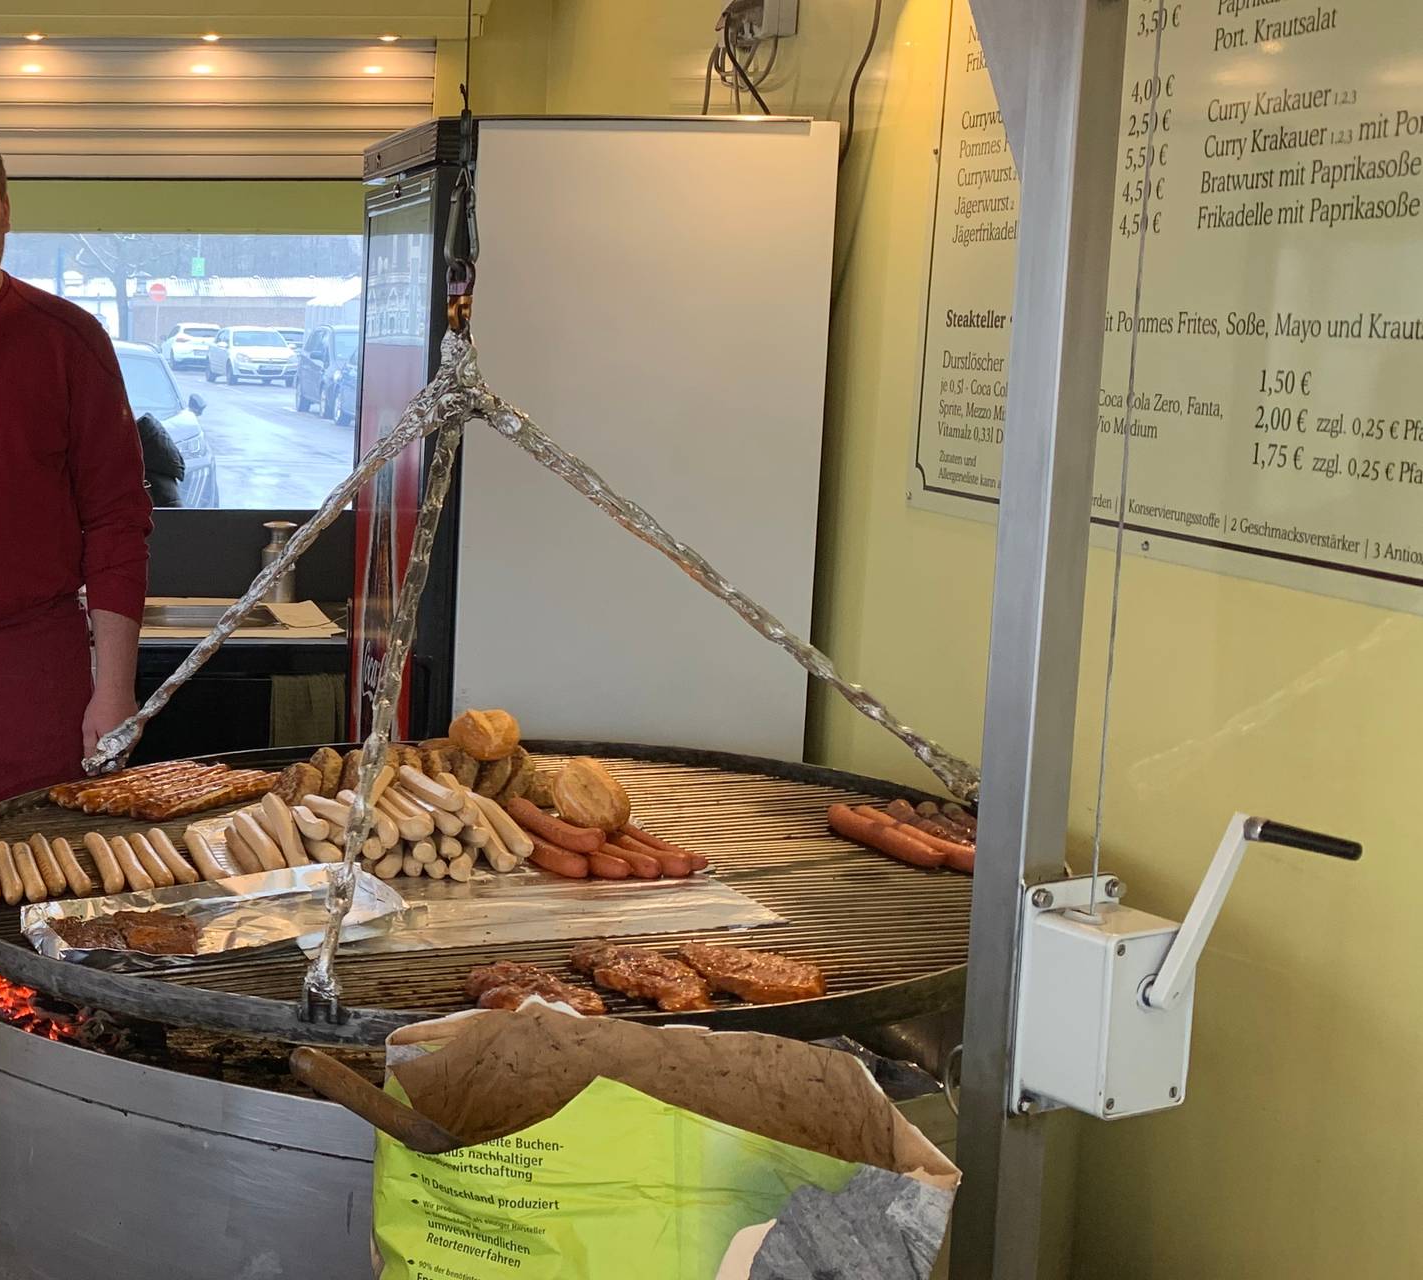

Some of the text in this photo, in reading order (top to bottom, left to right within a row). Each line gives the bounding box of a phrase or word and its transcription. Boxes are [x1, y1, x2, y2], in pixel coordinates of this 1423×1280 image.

[1172, 4, 1181, 27] €
[1214, 7, 1337, 51] Port. Krautsalat
[1166, 74, 1175, 97] €
[1208, 98, 1251, 124] Curry
[1254, 88, 1331, 117] Krakauer
[1162, 108, 1171, 132] €
[960, 139, 1001, 158] Pommes
[1204, 134, 1247, 160] Curry
[1250, 126, 1327, 153] Krakauer
[1358, 113, 1388, 141] mit
[1159, 143, 1168, 166] €
[957, 166, 1012, 189] Currywurst
[1201, 150, 1422, 194] Bratwurst mit Paprikasoße
[1156, 177, 1165, 200] €
[955, 196, 1009, 218] Jägerwurst
[1197, 191, 1421, 229] Frikadelle mit Paprikasoße
[952, 220, 1017, 247] Jägerfrikadel
[1152, 211, 1162, 233] €
[945, 309, 1006, 328] Steakteller
[1177, 311, 1220, 338] Frites,
[1226, 311, 1269, 339] Soße,
[1274, 312, 1322, 343] Mayo
[1327, 313, 1363, 339] und
[1368, 313, 1423, 340] Kraut
[942, 350, 1005, 372] Durstlöscher
[1259, 369, 1312, 397] 1,50 €
[965, 402, 991, 419] Mezzo
[970, 379, 991, 396] Coca
[993, 380, 1008, 398] Col
[1153, 393, 1183, 415] Zero,
[1186, 396, 1223, 420] Fanta,
[937, 421, 972, 440] Vitamalz
[1254, 405, 1423, 442] 2,00 € zzgl. 0,25 € Pfa
[1252, 442, 1423, 484] 1,75 € zzgl. 0,25 € Pfa
[1128, 499, 1221, 529] Konservierungsstoffe
[1230, 518, 1237, 532] 2
[1240, 518, 1361, 554] Geschmacksverstärker
[1372, 542, 1380, 559] 3
[1384, 543, 1423, 564] Antiox
[515, 1137, 564, 1151] Buchen-
[468, 1150, 543, 1168] nachhaltiger
[432, 1179, 495, 1205] Deutschland
[498, 1197, 560, 1210] produziert
[426, 1232, 521, 1268] Retortenverfahren
